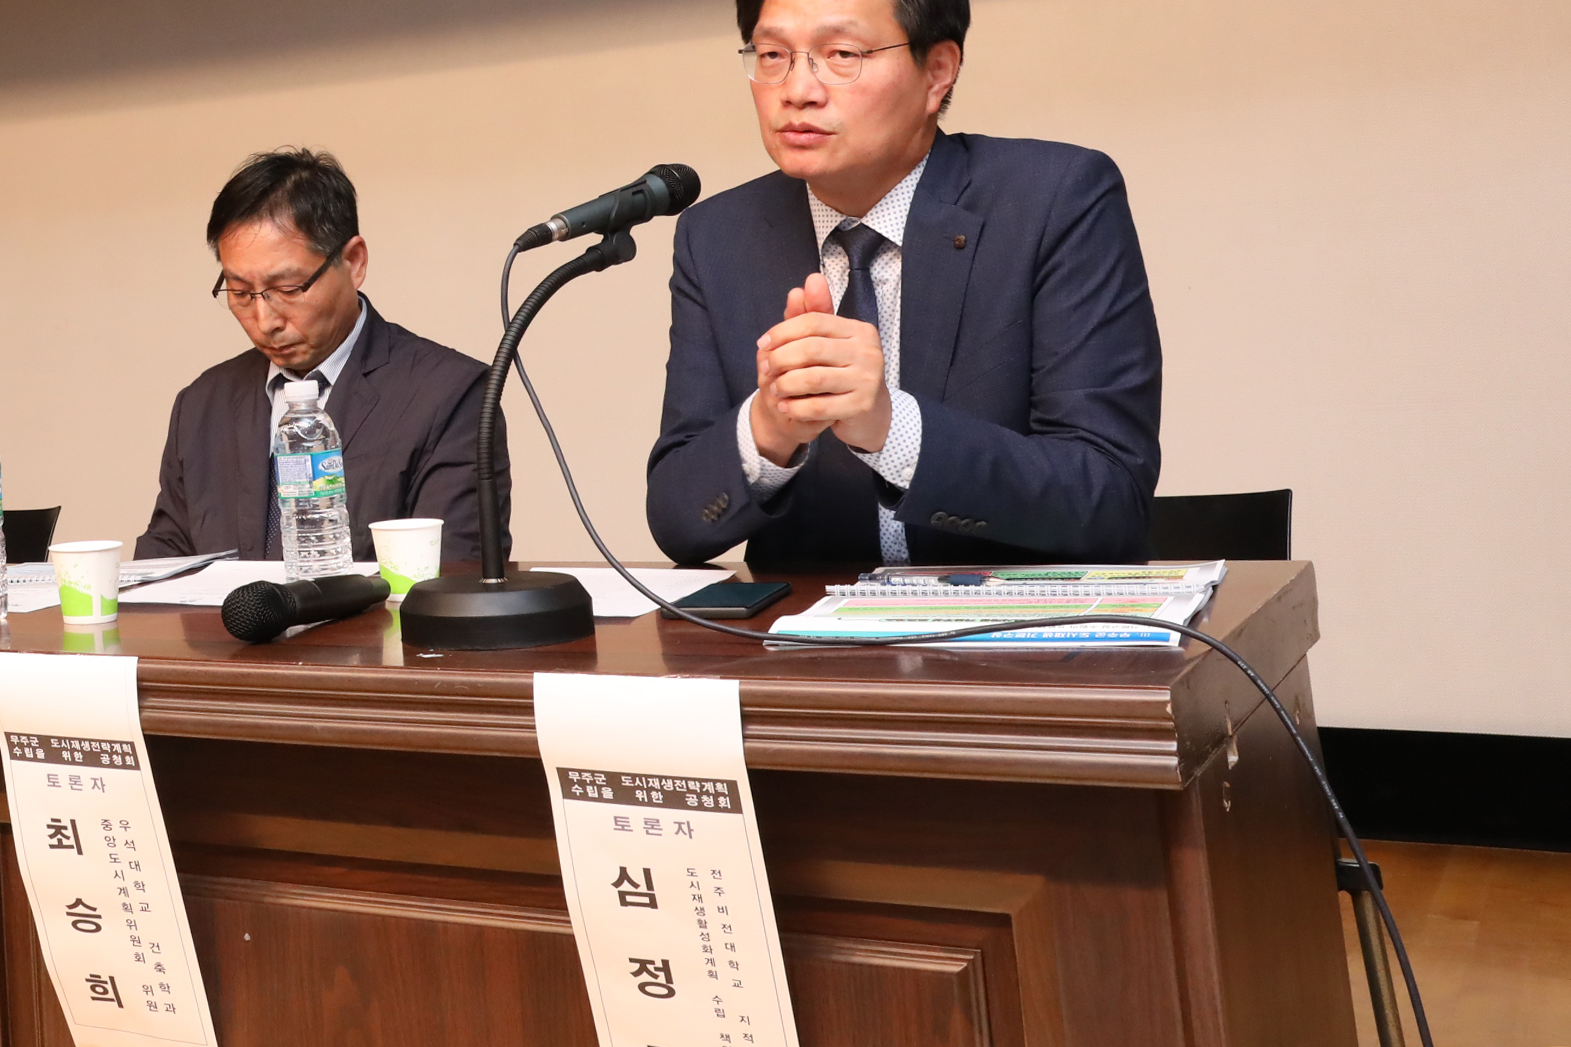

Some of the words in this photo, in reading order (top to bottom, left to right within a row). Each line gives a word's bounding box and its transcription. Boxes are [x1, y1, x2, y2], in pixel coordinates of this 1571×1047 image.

[10, 735, 39, 747] 무주군
[50, 738, 133, 754] 도시재생전략계획
[13, 746, 45, 759] 수립을
[62, 751, 83, 763] 위한
[100, 753, 135, 766] 공청회
[46, 773, 106, 793] 토론자
[568, 771, 607, 785] 무주군
[621, 775, 729, 795] 도시재생전략계획
[571, 784, 614, 799] 수립을
[635, 790, 663, 803] 위한
[685, 794, 731, 809] 공청회
[613, 815, 694, 839] 토론자
[46, 818, 124, 1008] 최승희
[101, 818, 146, 964] 중앙도시계획위원회
[142, 984, 159, 1012] 위원
[119, 819, 151, 913] 우석대학교
[149, 942, 176, 1014] 건축학과
[686, 867, 718, 980] 도시재생활성화계획
[712, 995, 726, 1018] 수립
[710, 869, 744, 988] 전주비전대학교
[611, 866, 676, 1047] 심정
